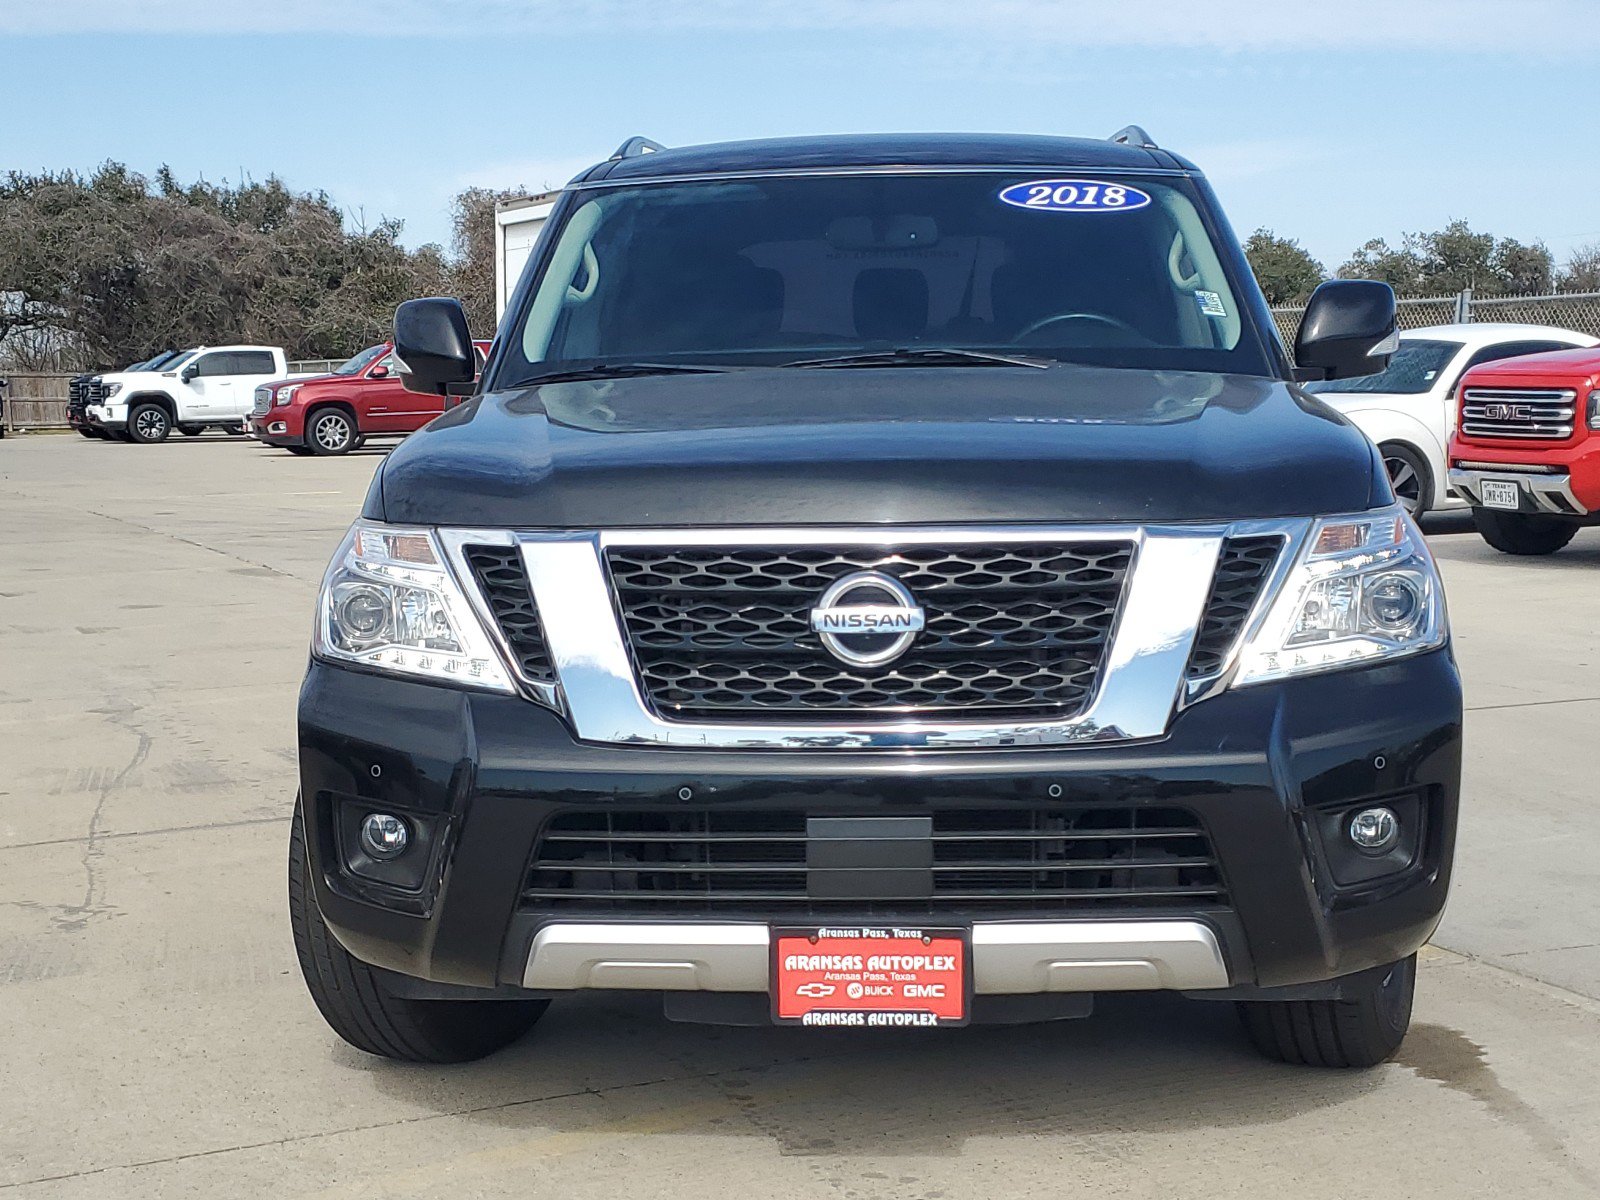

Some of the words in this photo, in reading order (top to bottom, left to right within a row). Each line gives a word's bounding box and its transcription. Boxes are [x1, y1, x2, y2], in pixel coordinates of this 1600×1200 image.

[1026, 186, 1126, 206] 2018
[1484, 404, 1531, 420] GMC
[824, 613, 911, 627] NISSAN
[818, 928, 860, 938] Aransas
[862, 928, 889, 939] Pass,
[893, 928, 923, 938] Texas
[785, 955, 863, 971] ARANSAS
[867, 955, 956, 971] AUTOPLEX
[824, 972, 860, 981] Aransas
[890, 972, 917, 981] Texas
[864, 985, 894, 995] BUICK
[903, 984, 945, 997] GMC
[802, 1012, 864, 1026] ARANSAS
[868, 1012, 938, 1026] AUTOPLEX
